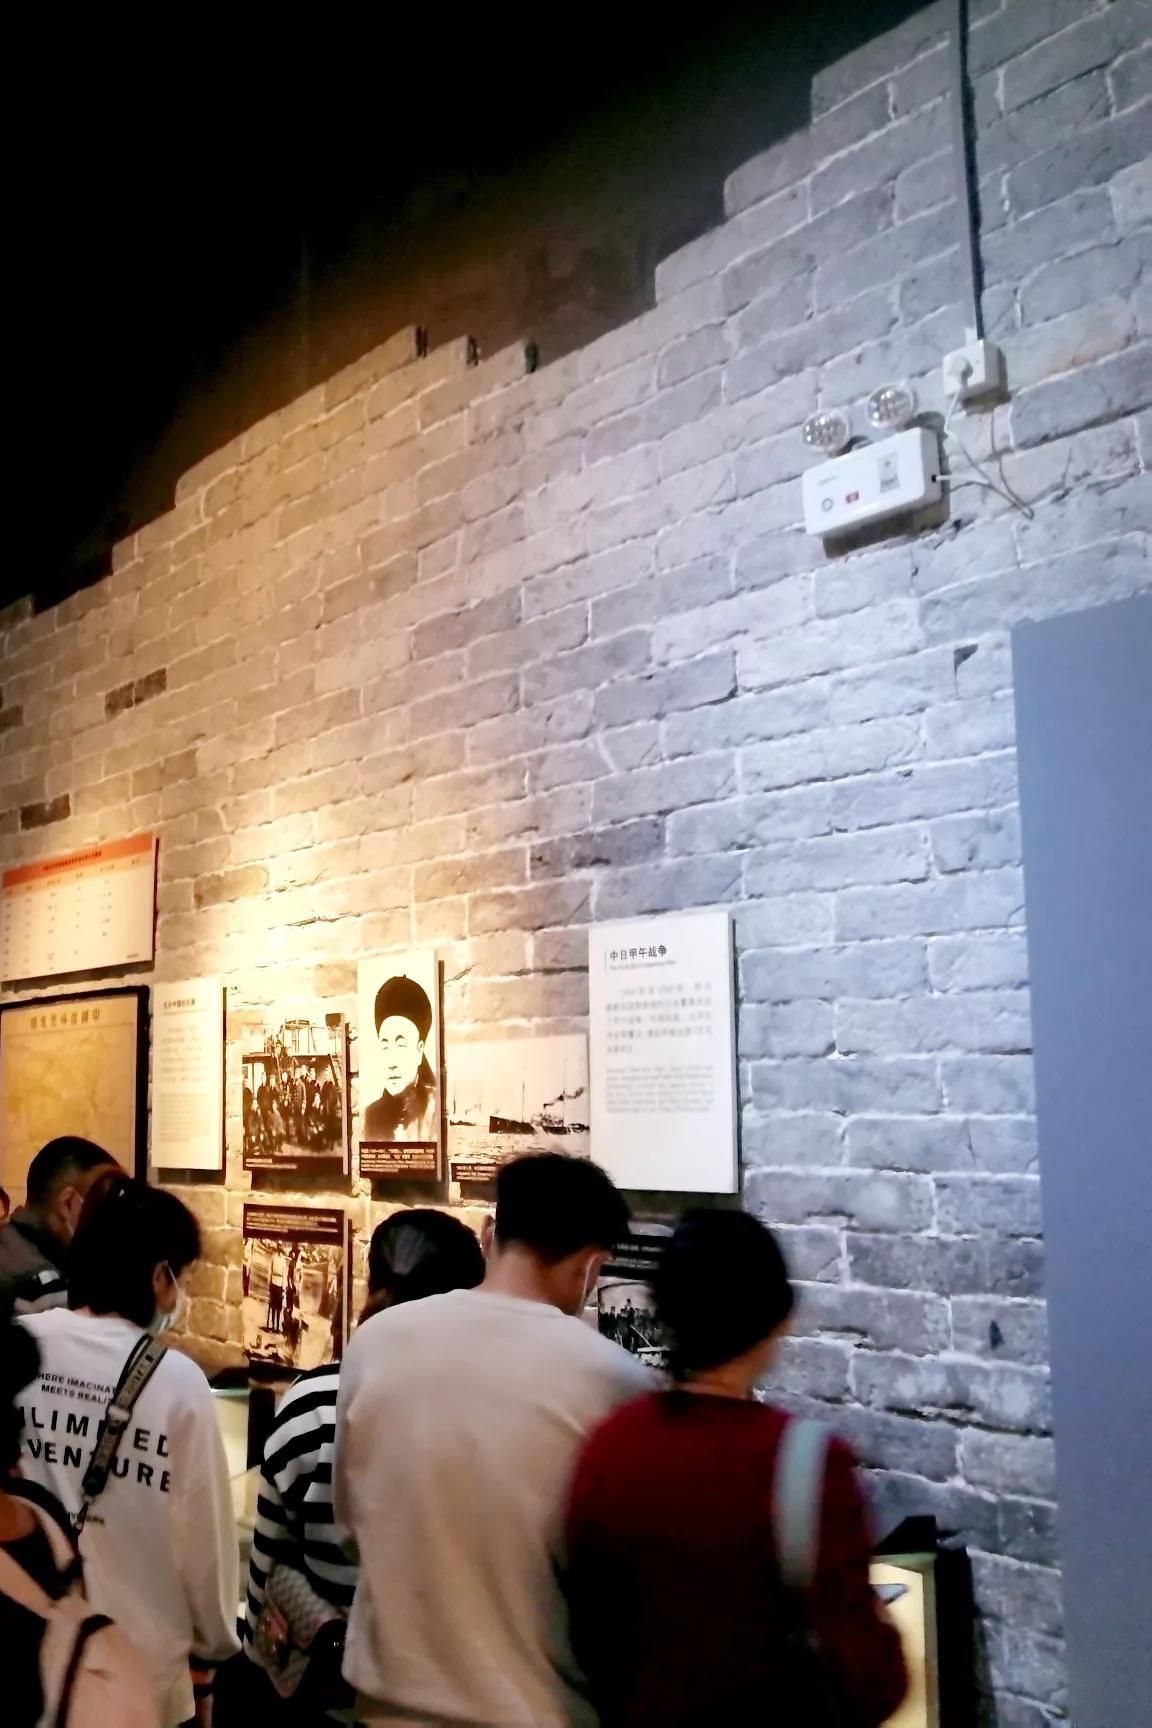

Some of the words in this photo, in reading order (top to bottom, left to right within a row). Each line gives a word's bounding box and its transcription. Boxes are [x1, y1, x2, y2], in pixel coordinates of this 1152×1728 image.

[610, 945, 667, 961] 中日甲午战争
[41, 1384, 75, 1397] MEETS
[28, 1438, 171, 1494] VENURE
